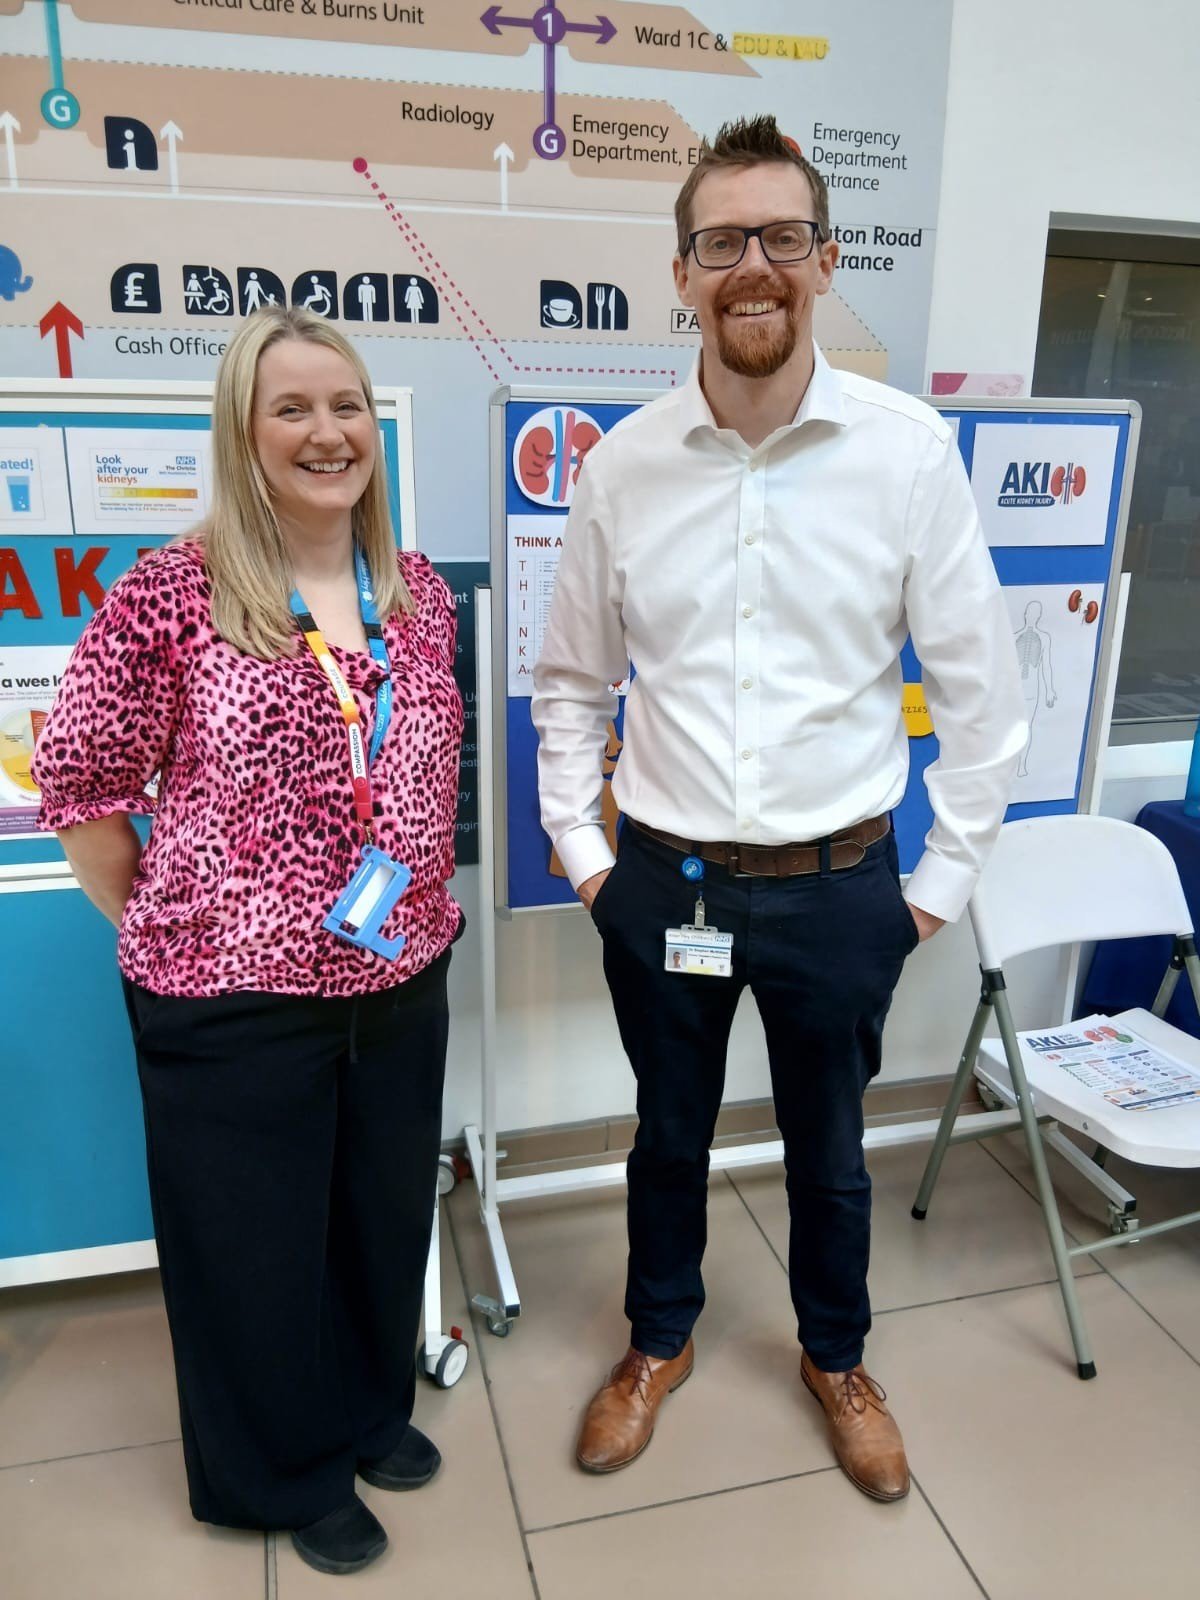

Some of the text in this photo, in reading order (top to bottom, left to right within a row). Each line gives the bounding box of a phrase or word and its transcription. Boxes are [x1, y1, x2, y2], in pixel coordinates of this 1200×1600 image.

[323, 1, 377, 20] Burns
[384, 3, 424, 24] Unit
[542, 12, 553, 37] 1
[635, 26, 681, 47] Ward
[687, 31, 709, 49] 1C
[714, 33, 728, 52] &
[50, 95, 71, 122] G
[402, 102, 494, 130] Radiology
[572, 114, 670, 141] Emergency
[813, 122, 901, 150] Emergency
[540, 129, 559, 153] G
[572, 140, 682, 166] Department,
[812, 146, 908, 170] Department
[822, 172, 880, 191] ntrance
[829, 225, 923, 247] ton Road
[115, 335, 228, 356] Cash Office
[95, 454, 122, 464] Look
[96, 464, 149, 476] after your
[97, 474, 138, 486] kidneys
[1000, 462, 1051, 494] AKI
[515, 536, 551, 548] THINK
[519, 560, 527, 571] T
[519, 580, 528, 591] H
[519, 627, 528, 638] N
[519, 645, 526, 656] K
[2, 678, 12, 688] a
[15, 677, 50, 688] wee
[330, 668, 348, 699] COURAGE
[352, 729, 363, 774] COMPASSION
[1026, 1036, 1067, 1048] AKI
